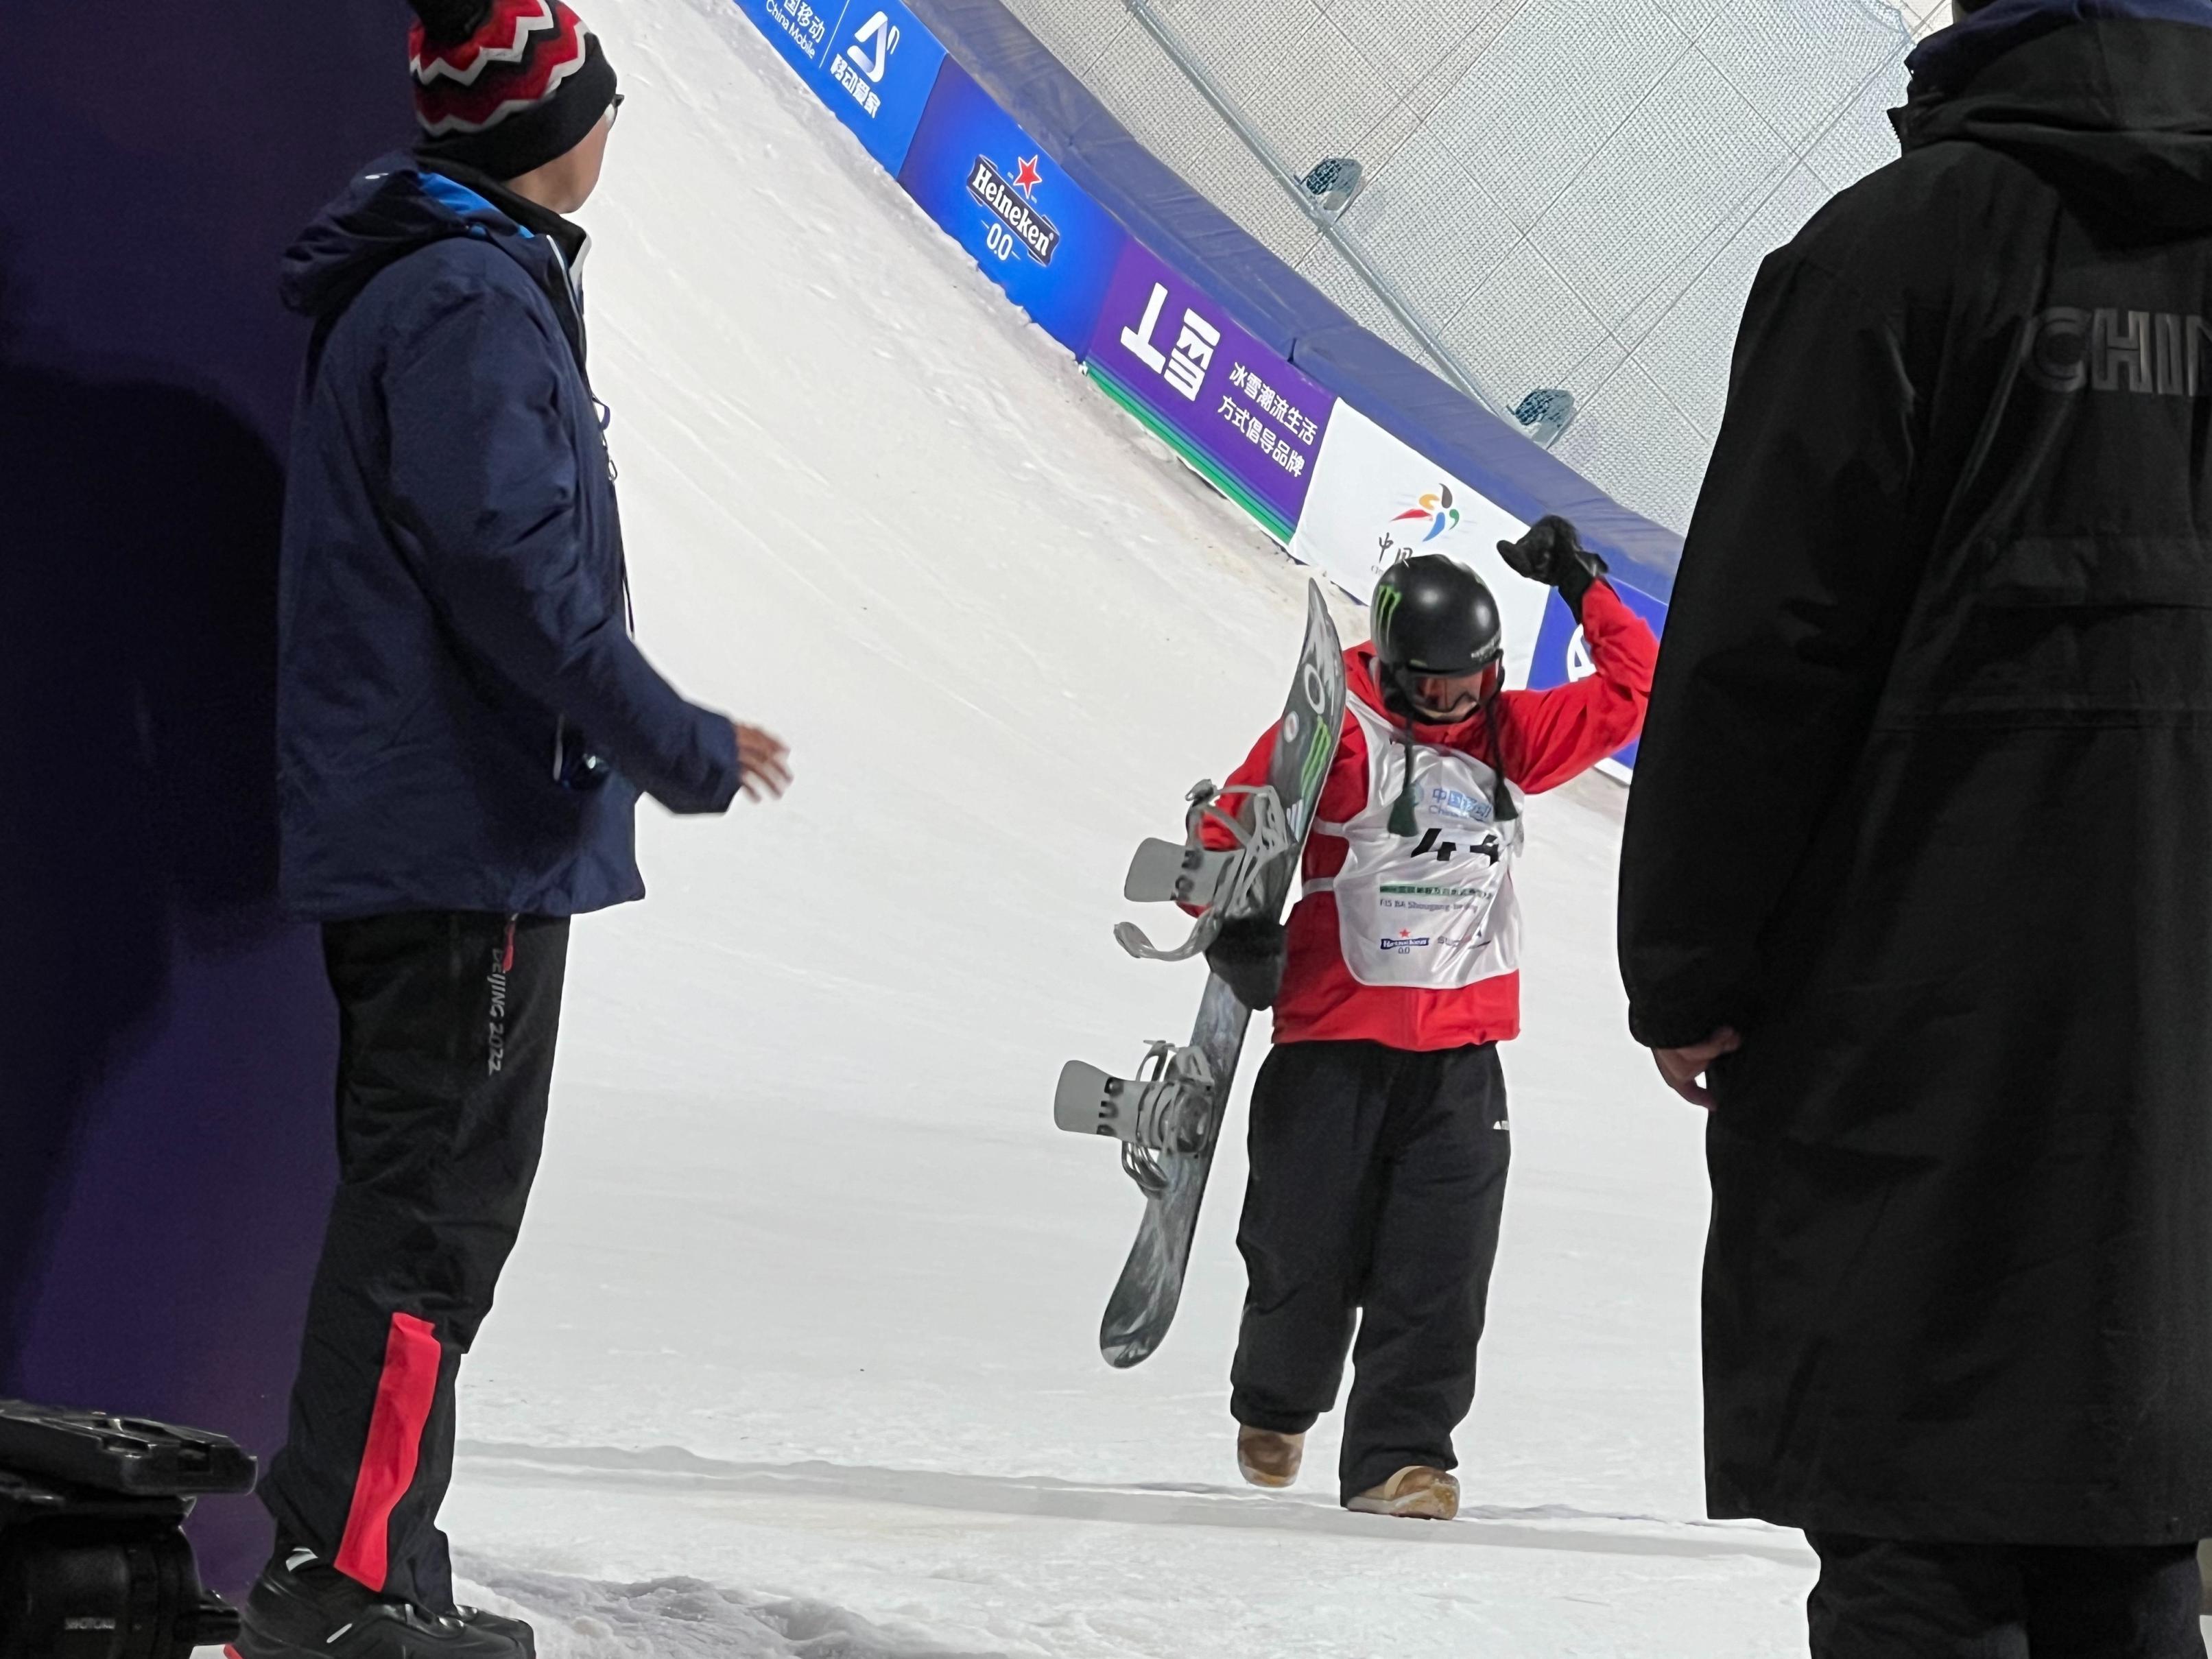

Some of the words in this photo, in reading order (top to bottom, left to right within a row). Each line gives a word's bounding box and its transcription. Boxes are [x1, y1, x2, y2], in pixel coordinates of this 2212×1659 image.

[789, 22, 816, 60] Mobile
[830, 53, 881, 119] 移动爱家
[986, 223, 1013, 261] 0.0
[1229, 361, 1318, 446] 冰雪潮流生活
[1217, 395, 1305, 477] 方式倡导品牌
[488, 1023, 504, 1076] 2022
